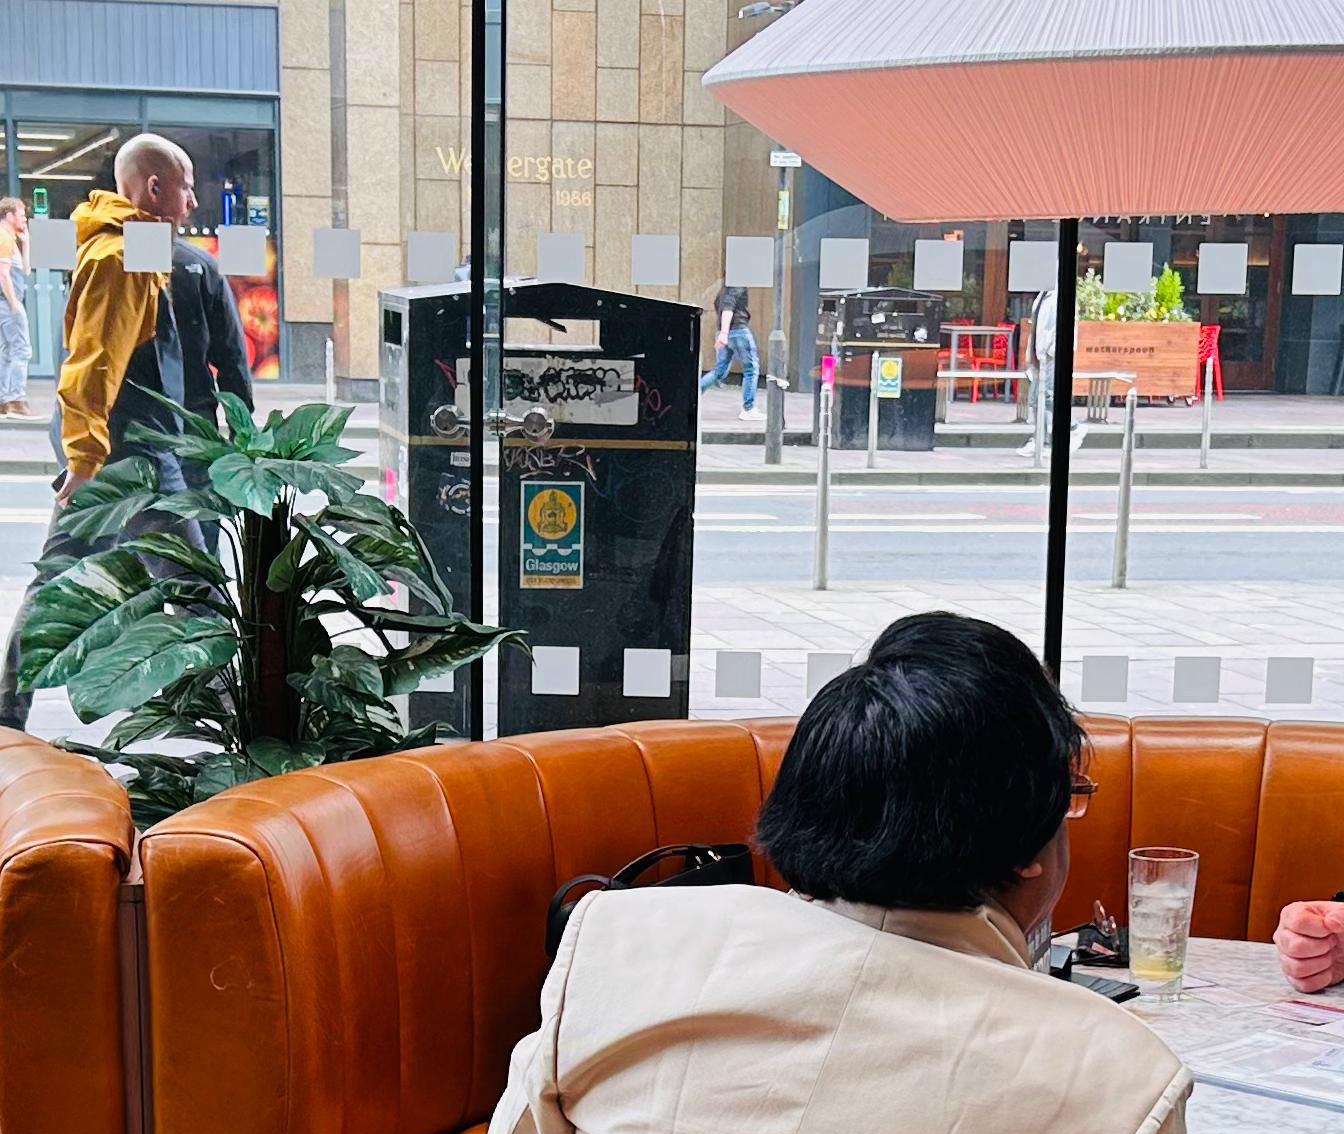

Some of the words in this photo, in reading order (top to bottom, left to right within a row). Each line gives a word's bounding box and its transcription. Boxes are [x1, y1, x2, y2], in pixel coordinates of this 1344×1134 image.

[436, 146, 593, 182] Weergate
[556, 189, 592, 207] 1986
[525, 558, 579, 574] Glasgow
